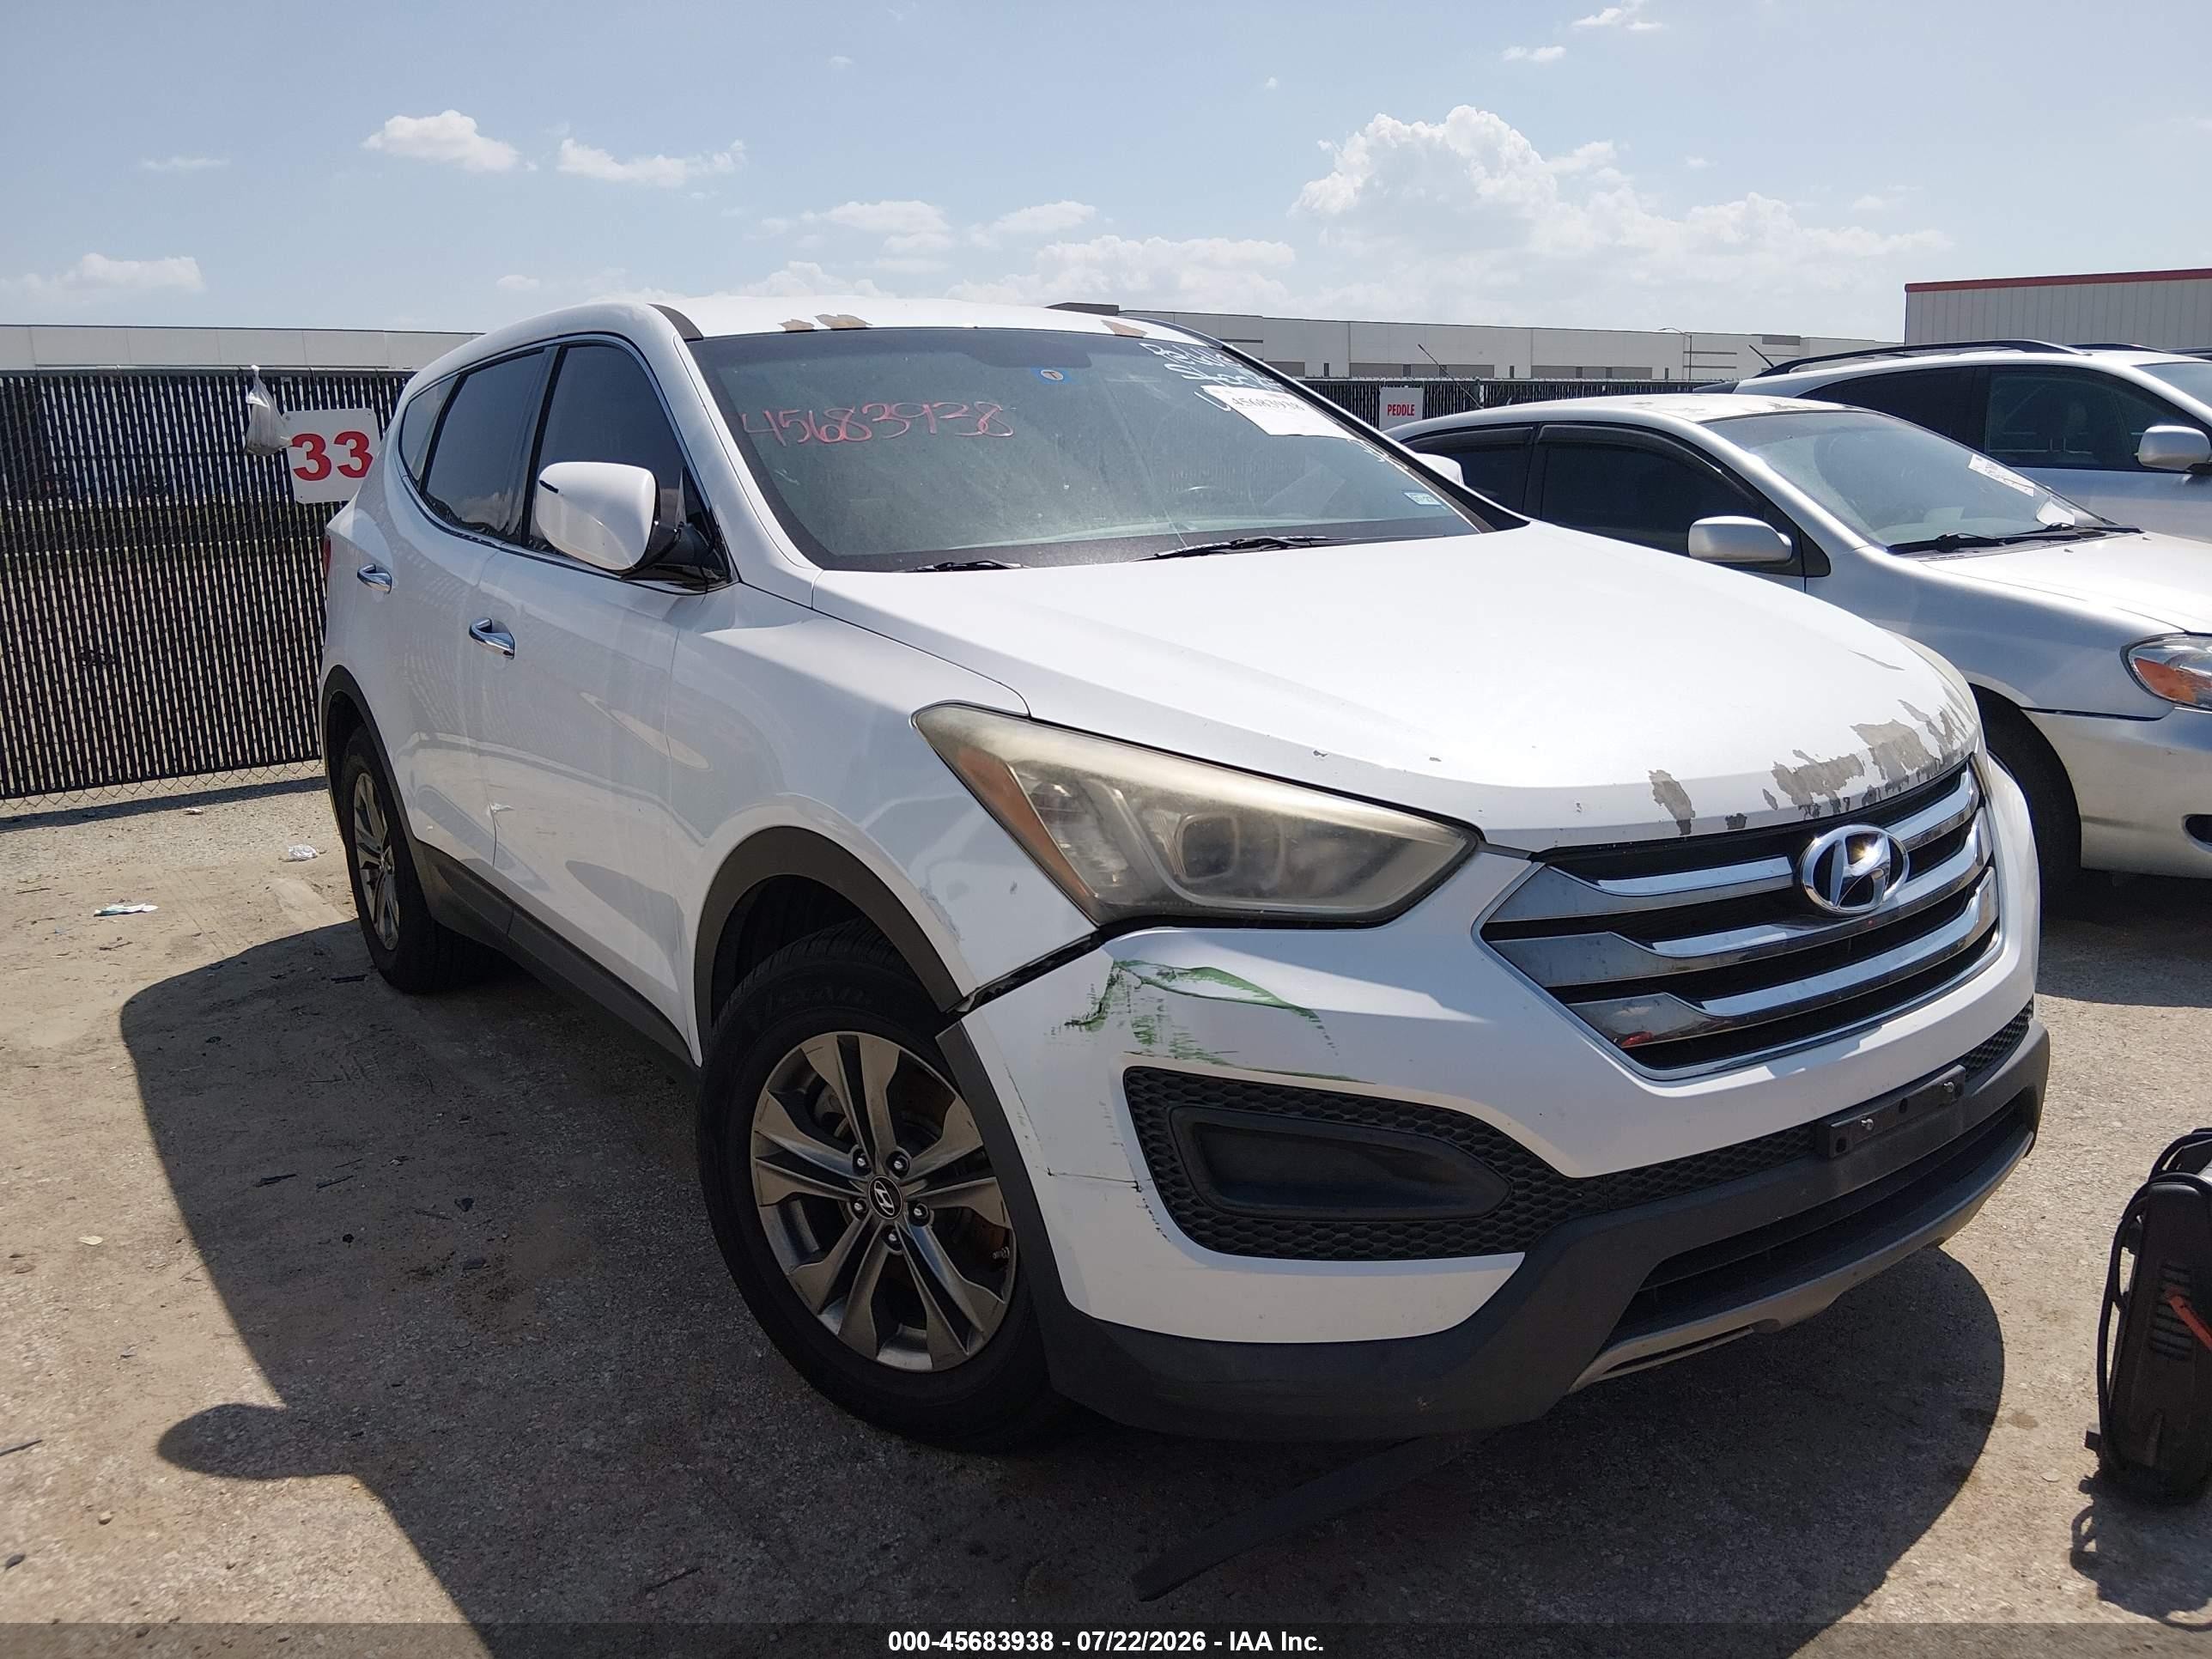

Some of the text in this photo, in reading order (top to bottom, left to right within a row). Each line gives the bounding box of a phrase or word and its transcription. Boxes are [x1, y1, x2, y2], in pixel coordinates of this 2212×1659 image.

[742, 400, 1014, 447] 45683938
[1387, 404, 1415, 416] PEDDLE
[291, 431, 374, 481] 33
